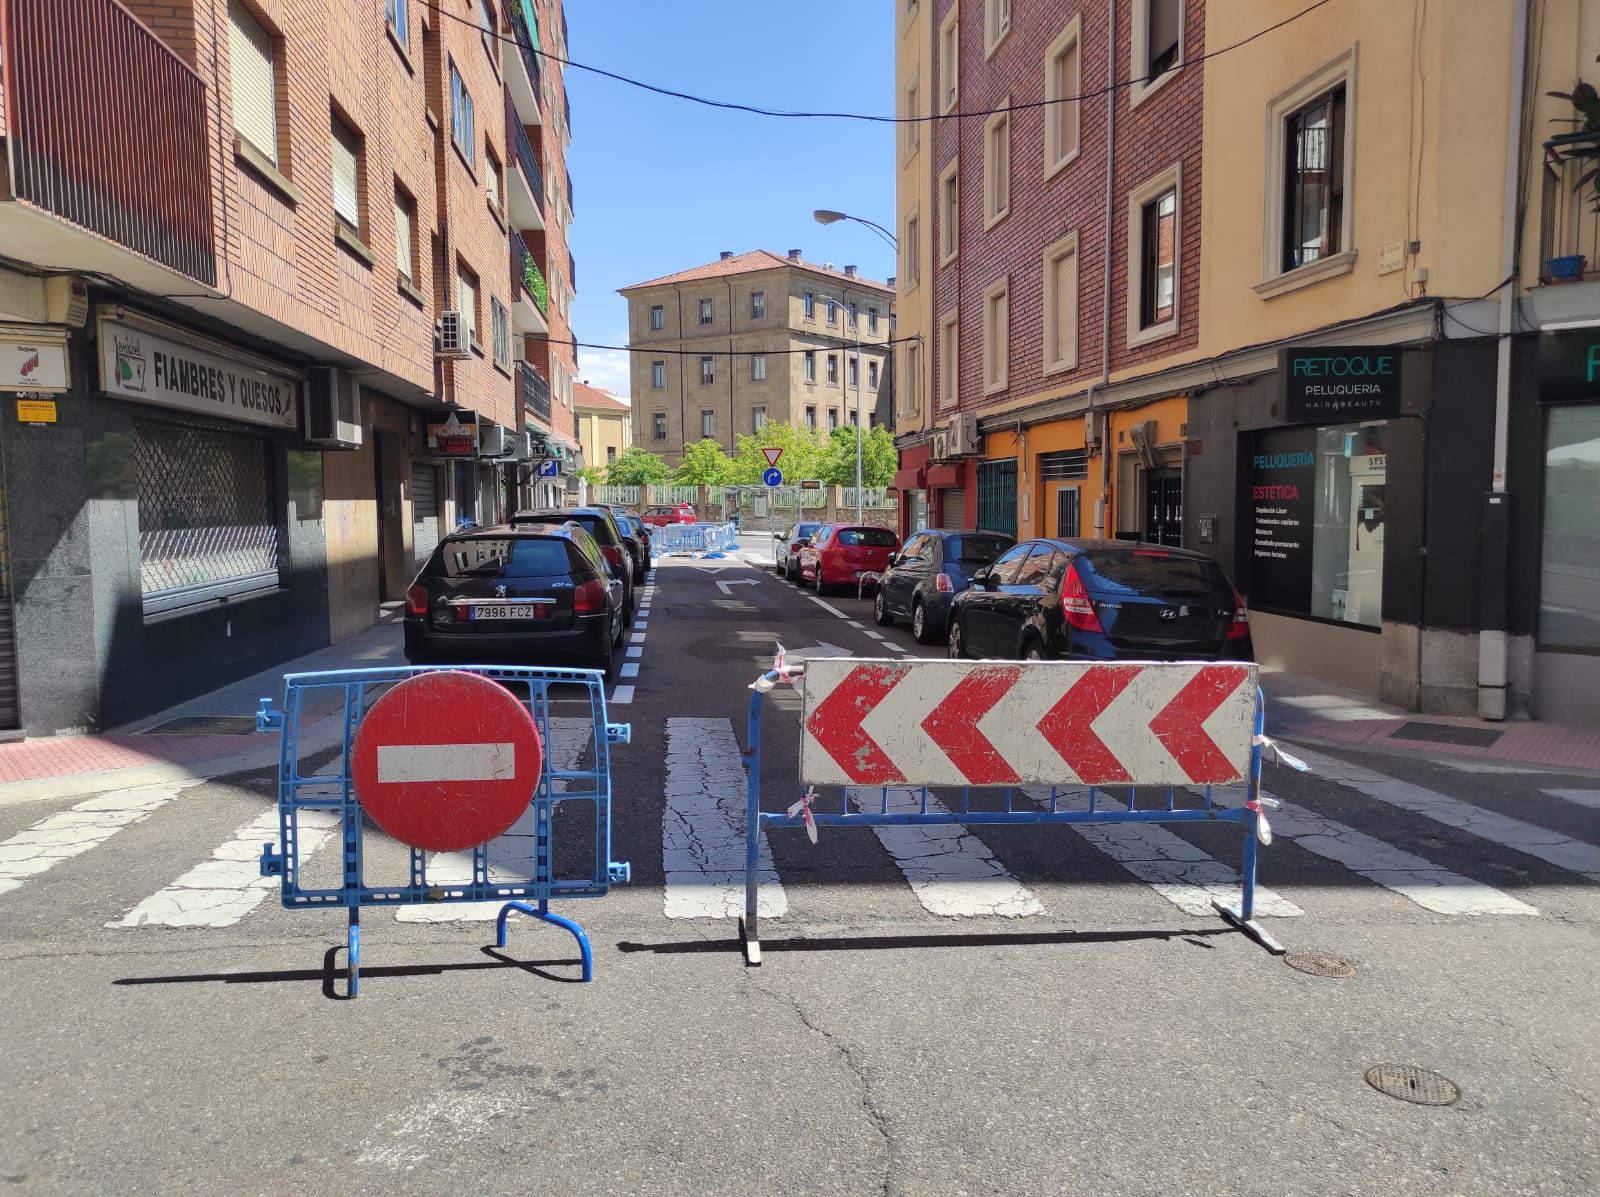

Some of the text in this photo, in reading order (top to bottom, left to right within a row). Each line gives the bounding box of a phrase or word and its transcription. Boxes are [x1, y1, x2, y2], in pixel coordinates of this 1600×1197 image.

[1294, 356, 1393, 376] RETOQUE
[154, 352, 281, 416] FIAMBRES Y QUESOS
[1305, 384, 1381, 396] PELUQUERIA
[1305, 401, 1330, 409] HAIR
[1340, 400, 1381, 408] BEAUTY
[1253, 451, 1314, 469] PELUQUERÍA
[1252, 483, 1298, 500] ESTÉTICA
[477, 607, 532, 618] 7996 FCZ
